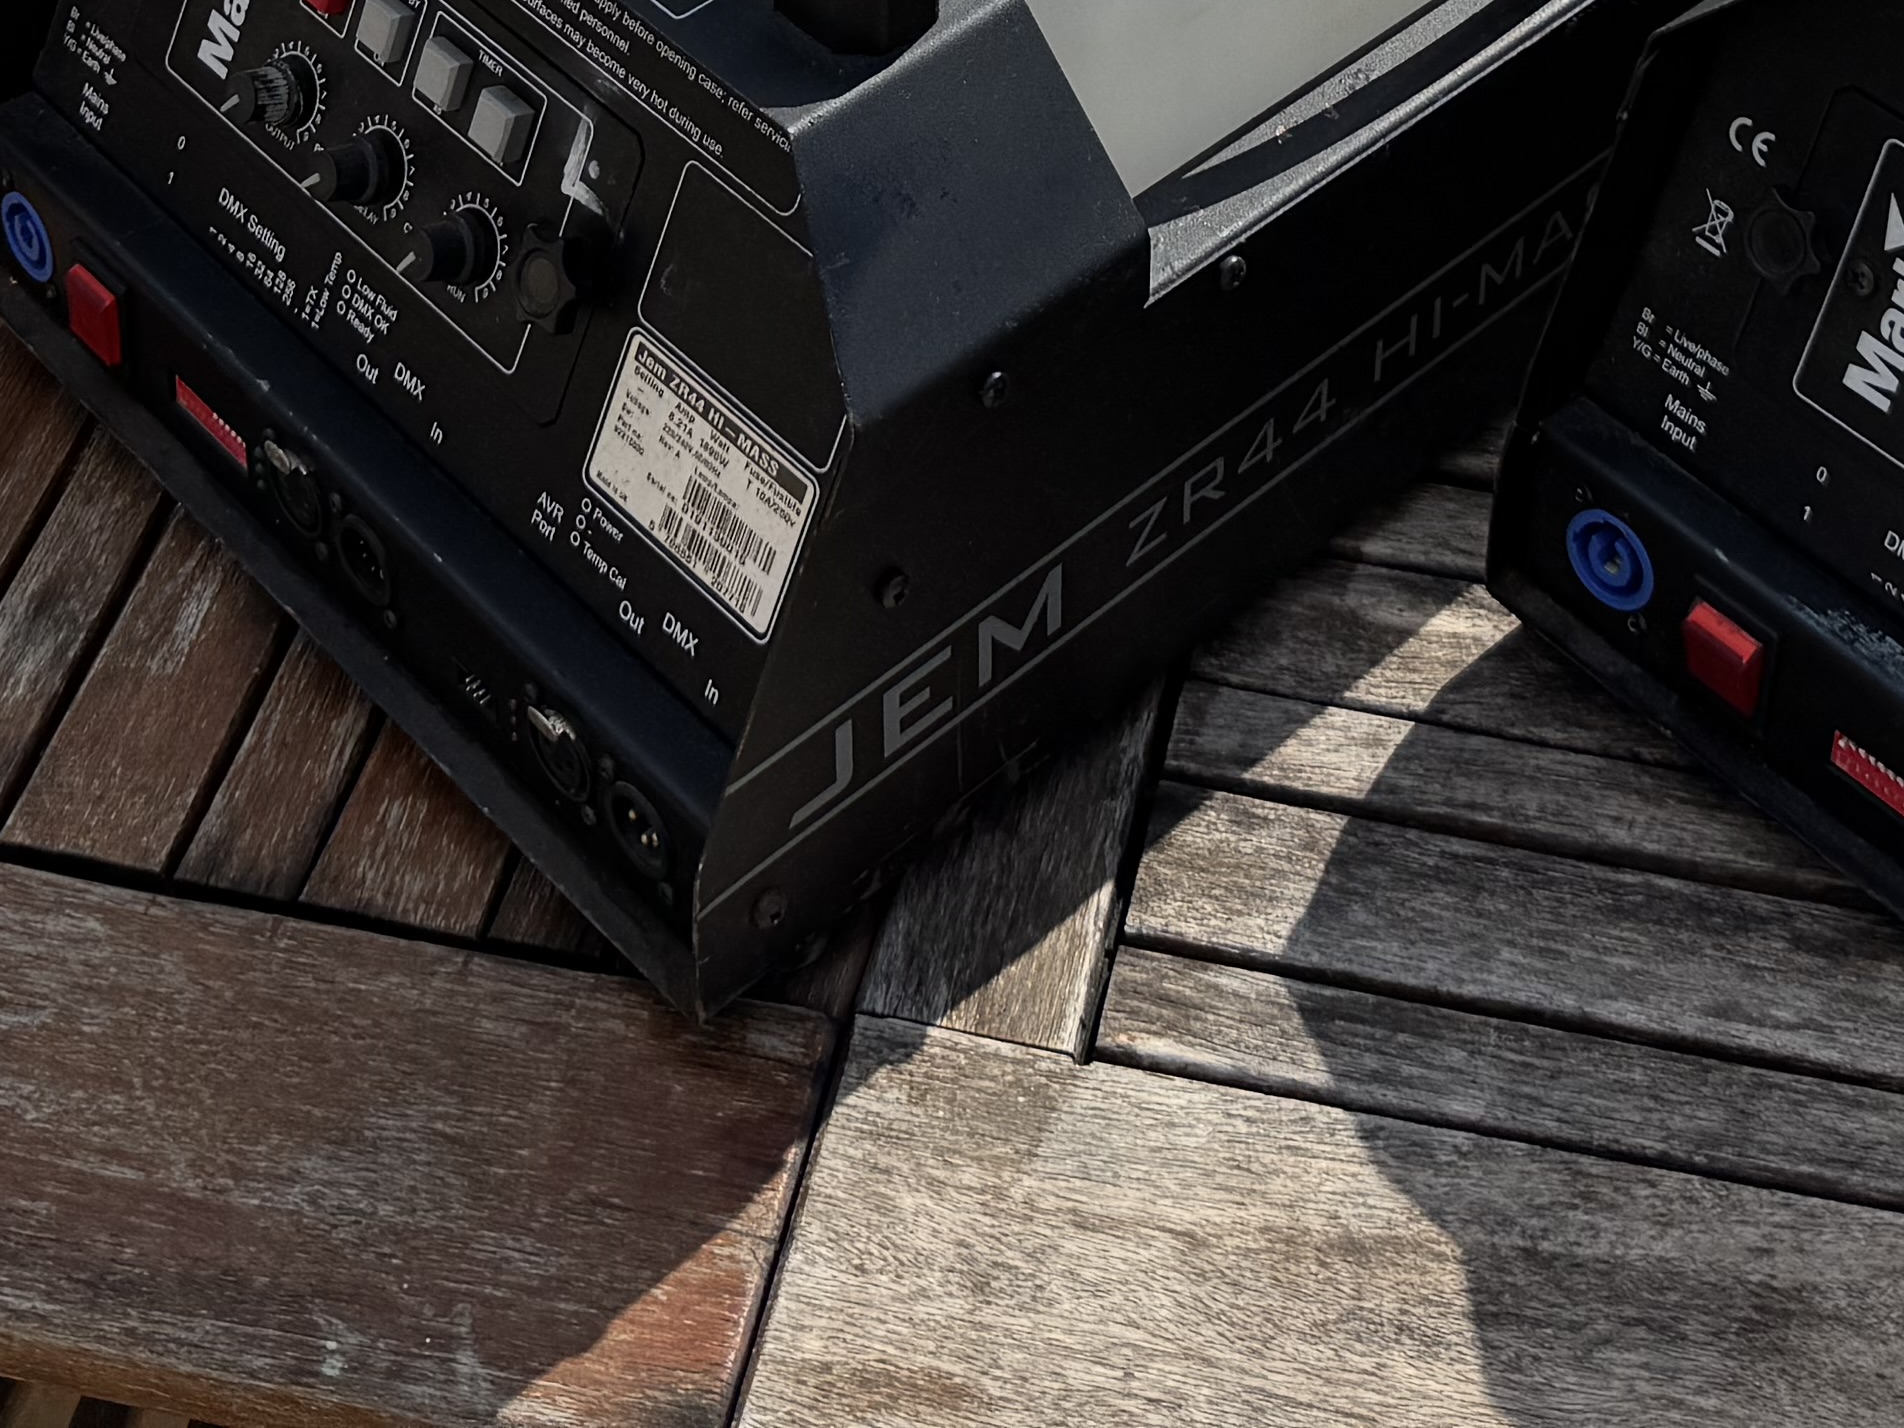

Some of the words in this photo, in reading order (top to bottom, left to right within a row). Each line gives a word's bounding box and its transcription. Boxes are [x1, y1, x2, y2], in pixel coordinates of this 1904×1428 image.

[578, 9, 630, 55] personnel.
[82, 82, 109, 114] Mains
[563, 23, 586, 48] may
[586, 39, 626, 78] become
[628, 73, 650, 99] very
[650, 89, 668, 113] hot
[668, 107, 701, 142] during
[702, 134, 723, 158] use.
[79, 100, 103, 131] Input
[218, 187, 248, 223] DMX
[247, 214, 286, 262] Setting
[351, 293, 374, 321] DMX
[374, 314, 390, 335] OK
[356, 277, 376, 301] Low
[375, 294, 398, 321] Fluid
[346, 309, 374, 342] Ready
[356, 353, 379, 384] Out
[394, 362, 425, 401] DMX
[638, 350, 666, 380] Jem
[669, 374, 704, 412] ZR44
[708, 407, 724, 429] HI
[736, 433, 779, 476] MASS
[1664, 393, 1706, 433] Mains
[430, 421, 443, 444] In
[1660, 414, 1696, 450] Input
[531, 508, 556, 541] Port
[537, 491, 564, 523] AVR
[592, 507, 623, 541] Power
[788, 564, 1064, 831] JEM
[1125, 376, 1337, 569] ZR44
[1372, 209, 1574, 385] HI-MA
[583, 540, 608, 573] Temp
[609, 566, 627, 590] Cal
[619, 600, 644, 634] Out
[662, 612, 699, 656] DMX
[704, 679, 719, 705] In
